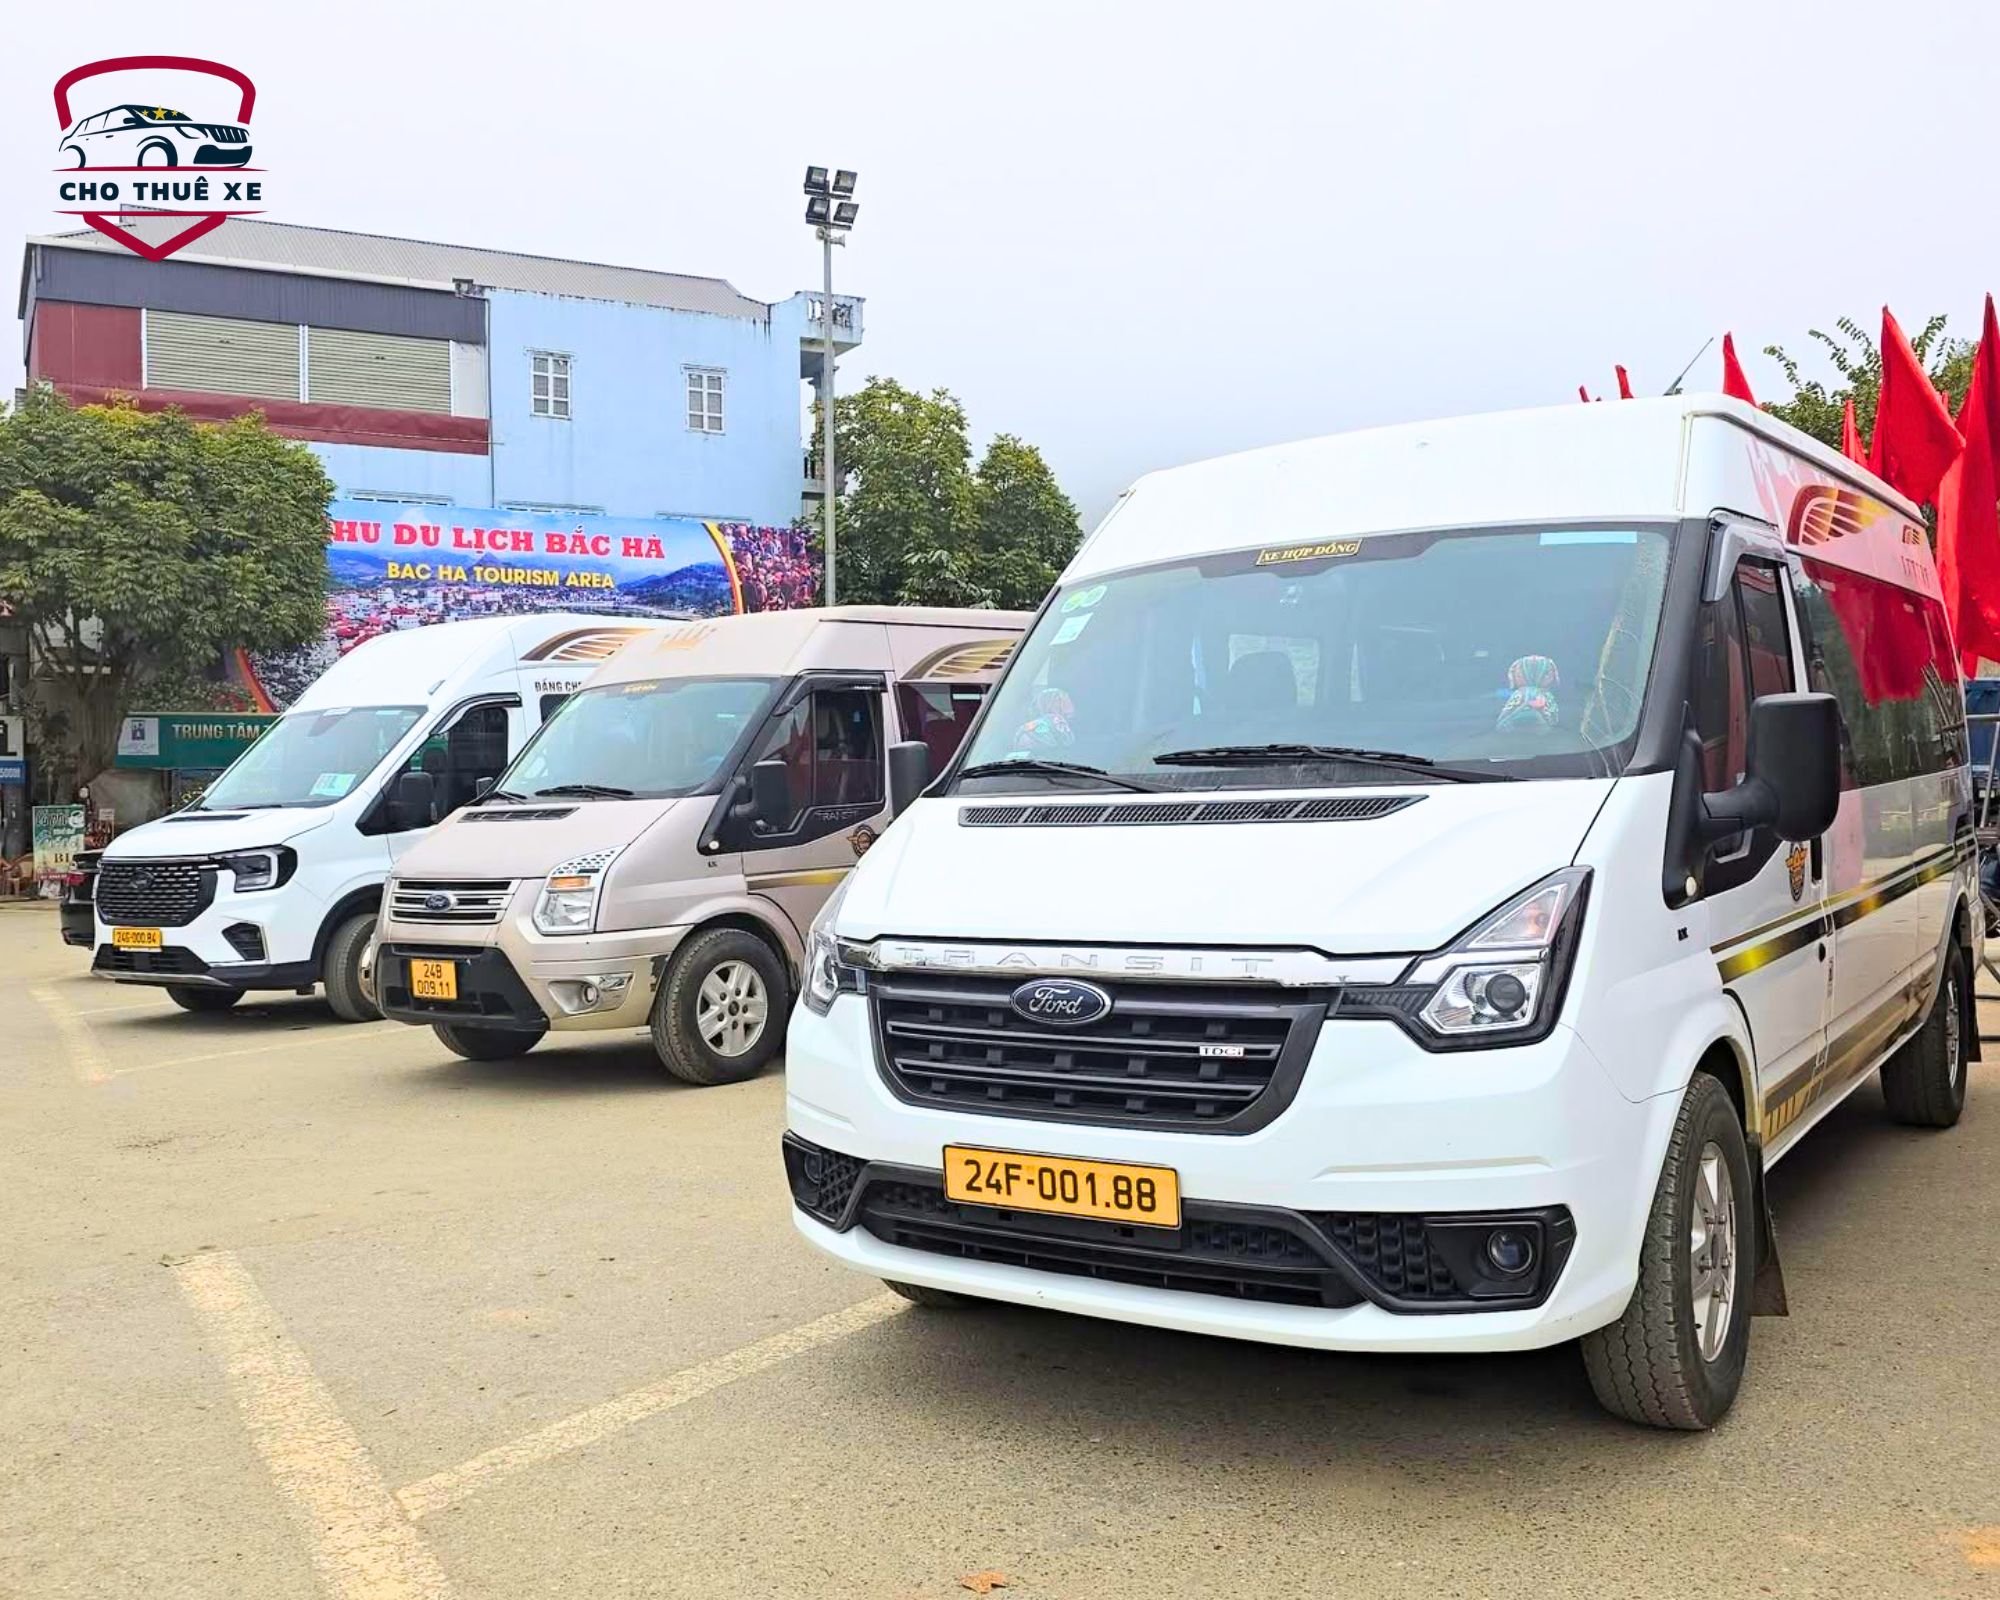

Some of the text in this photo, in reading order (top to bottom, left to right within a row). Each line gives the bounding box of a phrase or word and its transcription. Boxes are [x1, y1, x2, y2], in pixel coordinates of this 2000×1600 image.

[333, 520, 665, 559] HU DU LỊCH BẮC HÀ
[387, 561, 614, 588] BAC HA TOURISM AREA
[172, 723, 223, 739] TRUNG
[227, 722, 260, 739] TÂM
[423, 963, 442, 979] 24B
[895, 947, 1274, 973] TRANSIT
[417, 979, 451, 996] 009.11
[1029, 986, 1084, 1017] Ford
[963, 1158, 1158, 1213] 24F-001.88
